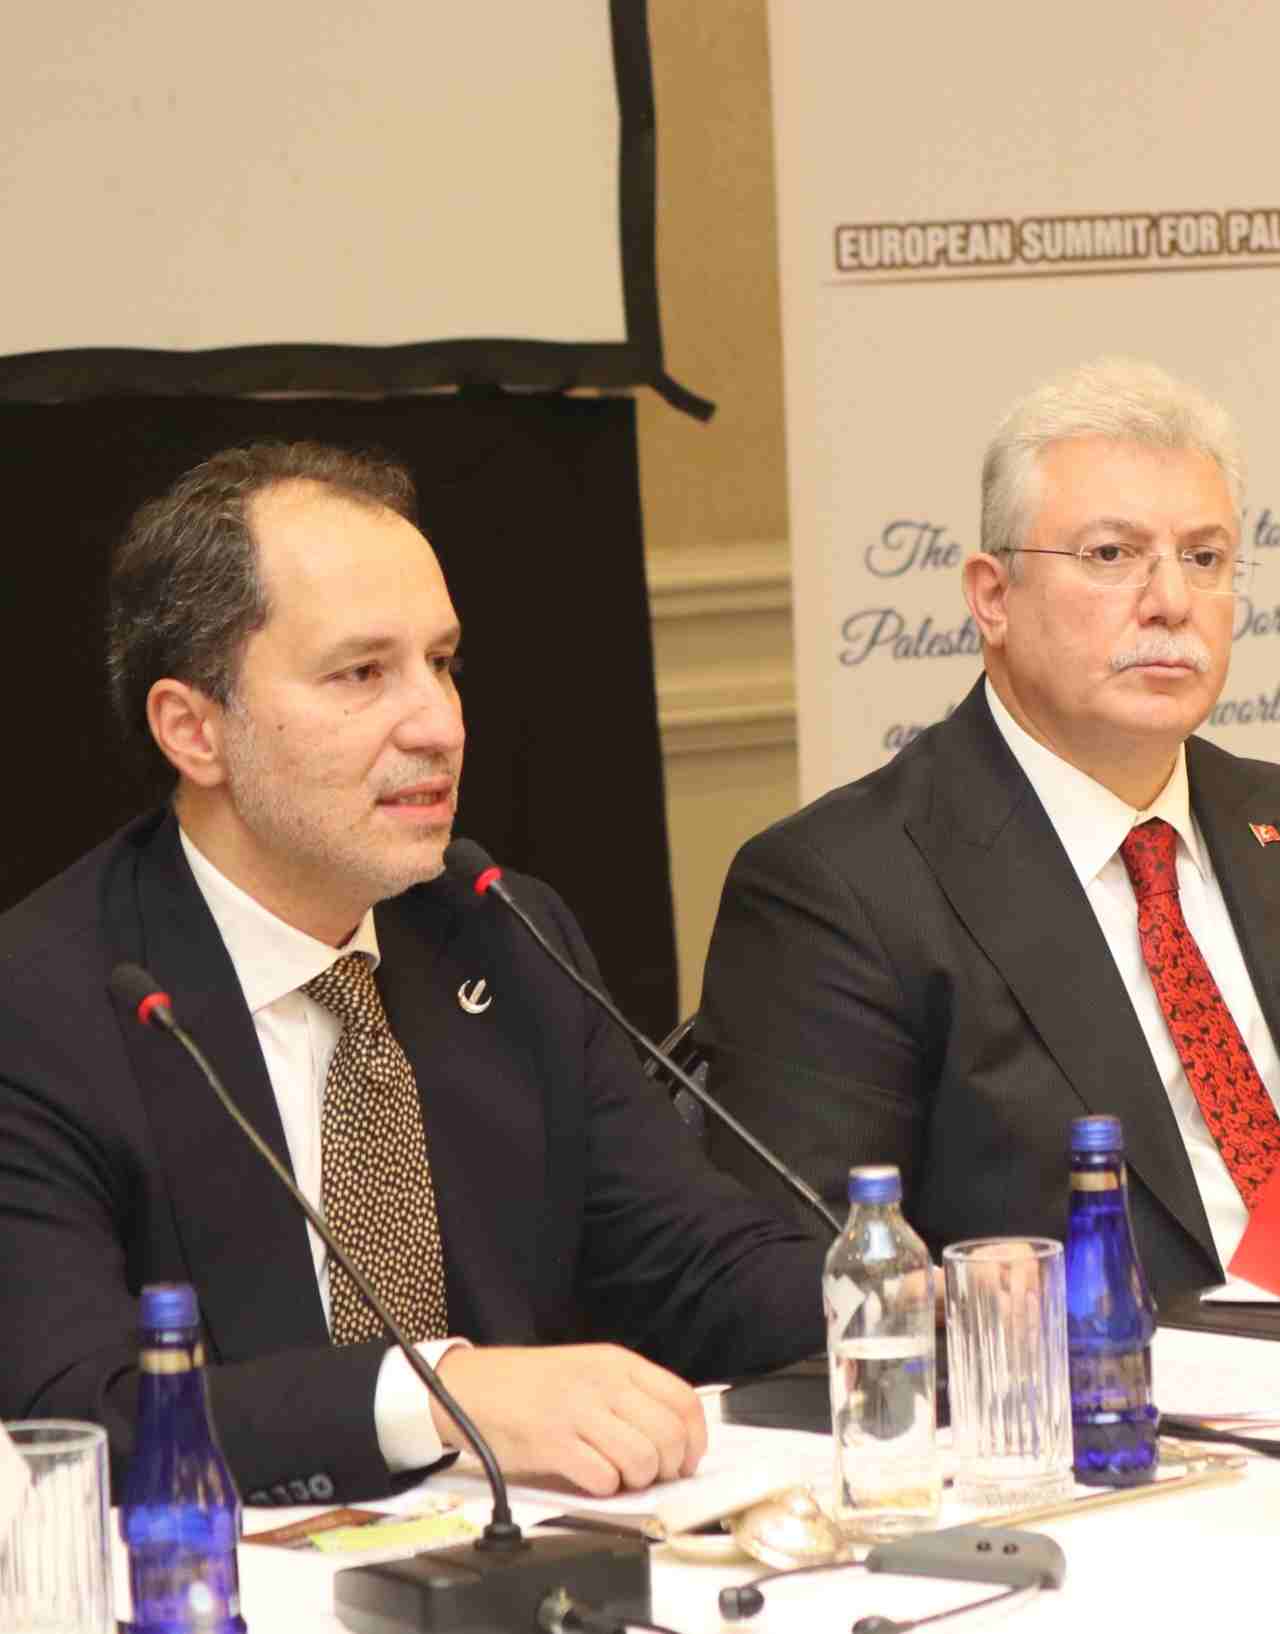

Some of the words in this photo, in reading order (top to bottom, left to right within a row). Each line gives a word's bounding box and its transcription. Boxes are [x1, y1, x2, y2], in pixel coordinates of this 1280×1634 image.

[836, 218, 1014, 272] EUROPEAN
[1018, 212, 1153, 264] SUMMIT
[1156, 209, 1223, 257] FOR
[864, 520, 961, 578] The
[840, 608, 980, 667] Palesti
